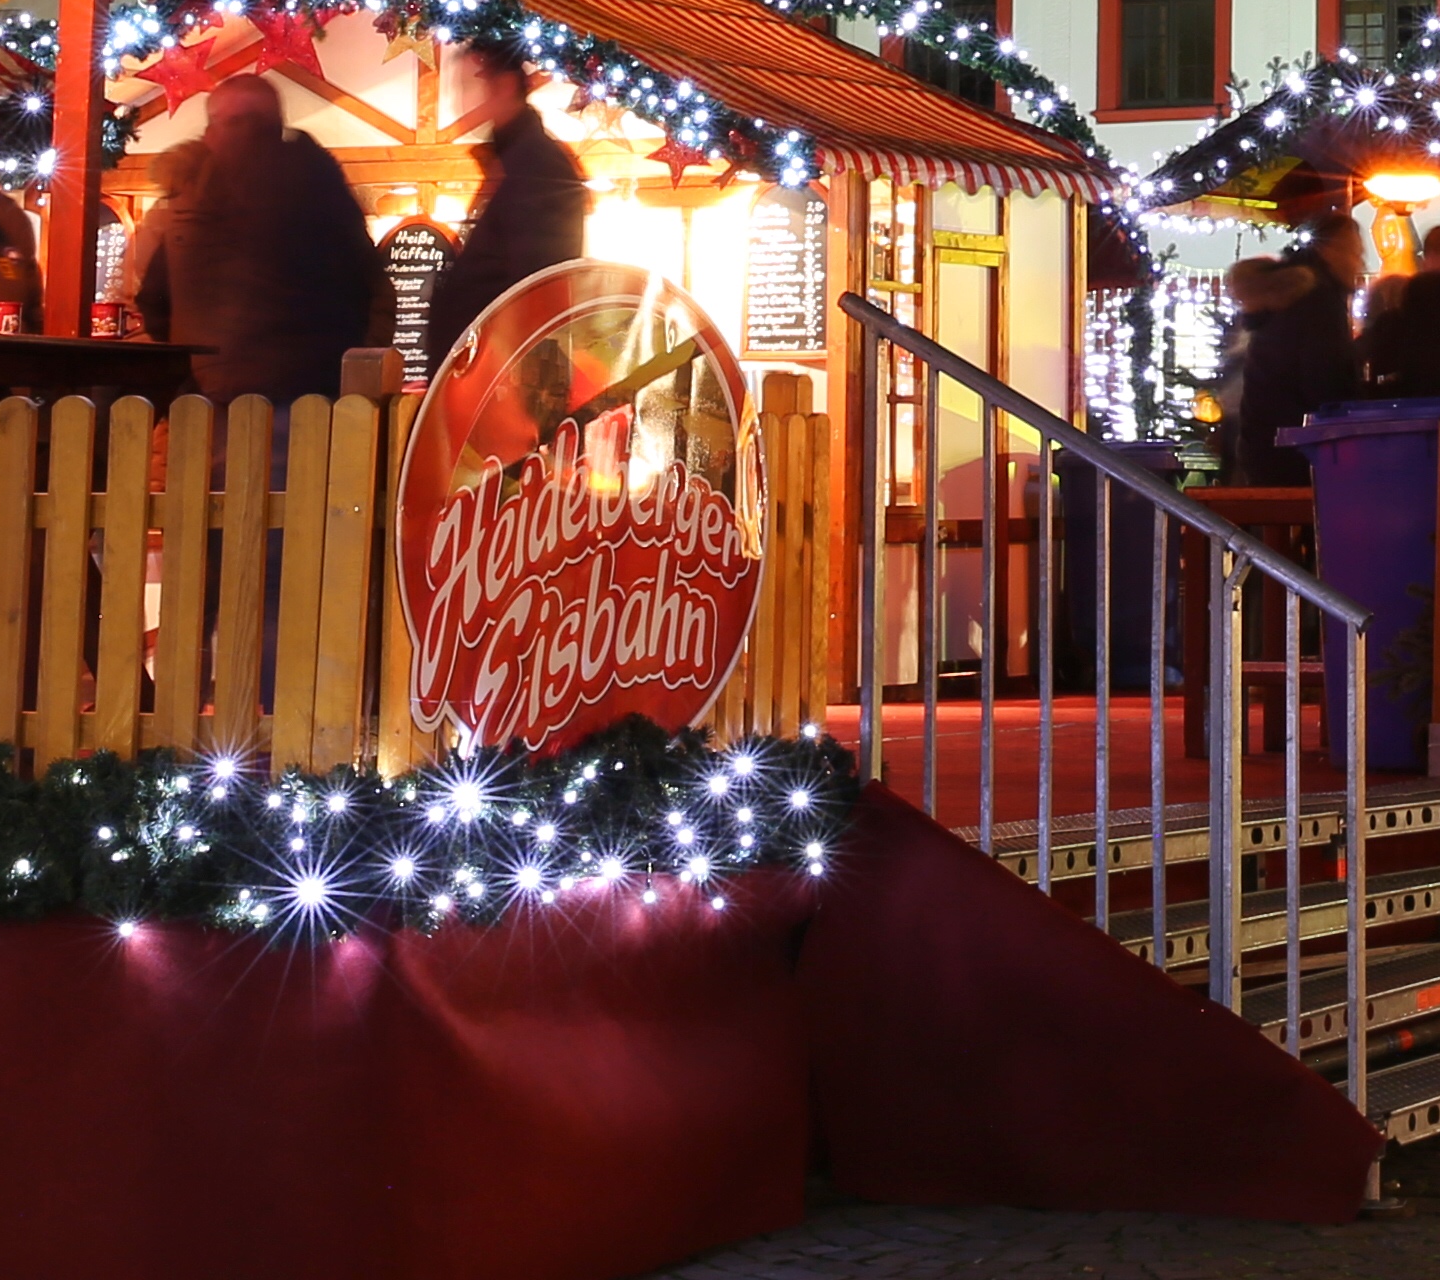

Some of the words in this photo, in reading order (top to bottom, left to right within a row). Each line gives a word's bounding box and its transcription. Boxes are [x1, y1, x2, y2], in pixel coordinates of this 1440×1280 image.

[390, 246, 444, 261] Waffeln
[395, 230, 435, 245] Heiße
[421, 418, 742, 697] Heidelberger
[474, 548, 705, 736] Eisbahn
